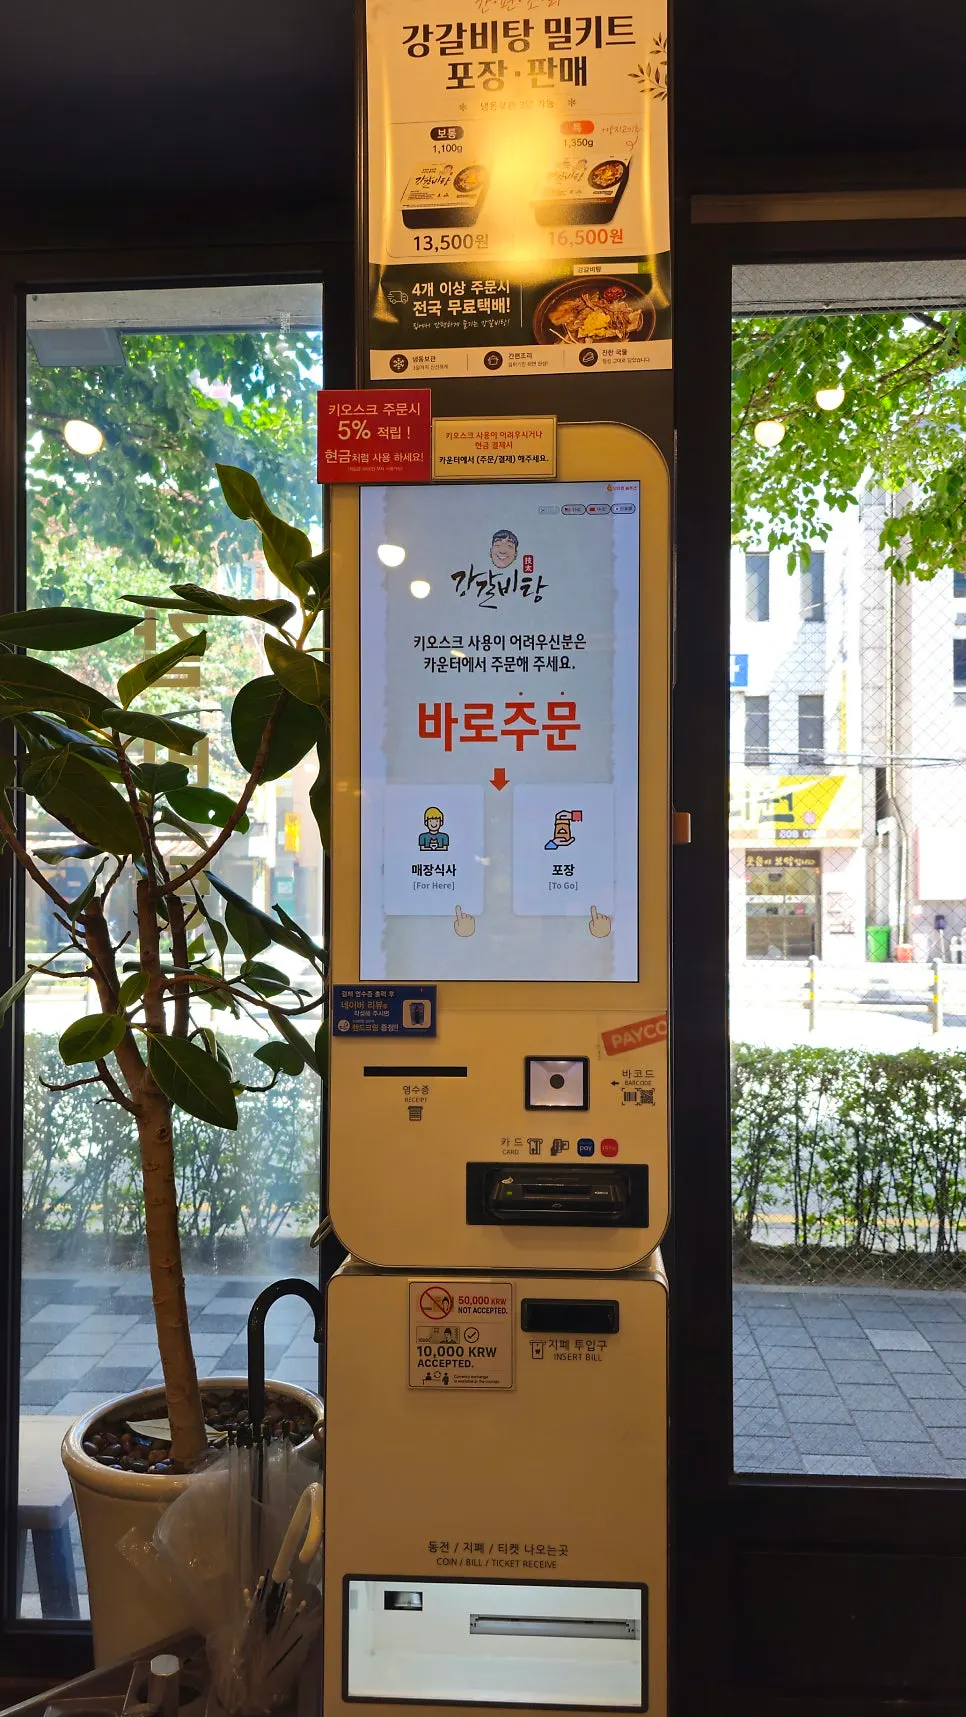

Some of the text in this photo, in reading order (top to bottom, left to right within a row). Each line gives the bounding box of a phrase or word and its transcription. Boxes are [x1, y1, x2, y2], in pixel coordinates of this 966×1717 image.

[402, 15, 636, 58] 강갈비탕 밀키트
[437, 128, 457, 139] 보통
[432, 144, 462, 153] 1,100g
[563, 138, 594, 149] 1,350g
[413, 233, 489, 252] 13,500원
[549, 228, 623, 248] 16,500원
[411, 280, 510, 297] 4개 이상 주문시
[413, 297, 511, 317] 전국 무료택배!
[328, 402, 420, 417] 키오스크 주문시
[338, 419, 371, 440] 5%
[377, 426, 401, 439] 적립
[446, 431, 543, 440] 키오스크 사용이 어려우시거나
[475, 441, 513, 449] 현금 결제시
[325, 450, 424, 463] 현금처럼 사용 하세요!
[439, 454, 549, 464] 카운터에서 (주문/결제) 해주세요.
[451, 563, 549, 609] 강갈비탕
[414, 633, 587, 651] 키오스크 사용이 어려우신분은
[424, 656, 575, 673] 카운터에서 주문해 주세요.
[419, 701, 581, 752] 바로주문
[411, 863, 457, 877] 매장식사
[552, 863, 575, 877] 포장
[413, 881, 455, 891] [For Here]
[548, 881, 578, 891] [To Go]
[341, 1001, 364, 1010] 네이버
[611, 1020, 667, 1049] PAYCO
[622, 1069, 654, 1079] 바코드
[402, 1085, 429, 1095] 영수증
[458, 1296, 489, 1306] 50,000
[458, 1306, 508, 1315] NOT ACCEPTED.
[417, 1346, 497, 1358] 10,000 KRW
[549, 1340, 607, 1352] 지폐 투입구
[418, 1359, 474, 1368] ACCEPTED.
[428, 1541, 449, 1553] 동전
[463, 1542, 485, 1554] 지폐
[498, 1543, 520, 1555] 티켓
[436, 1558, 457, 1566] COIN
[466, 1559, 482, 1567] BILL
[492, 1560, 519, 1568] TICKET
[523, 1560, 557, 1569] RECEIVE
